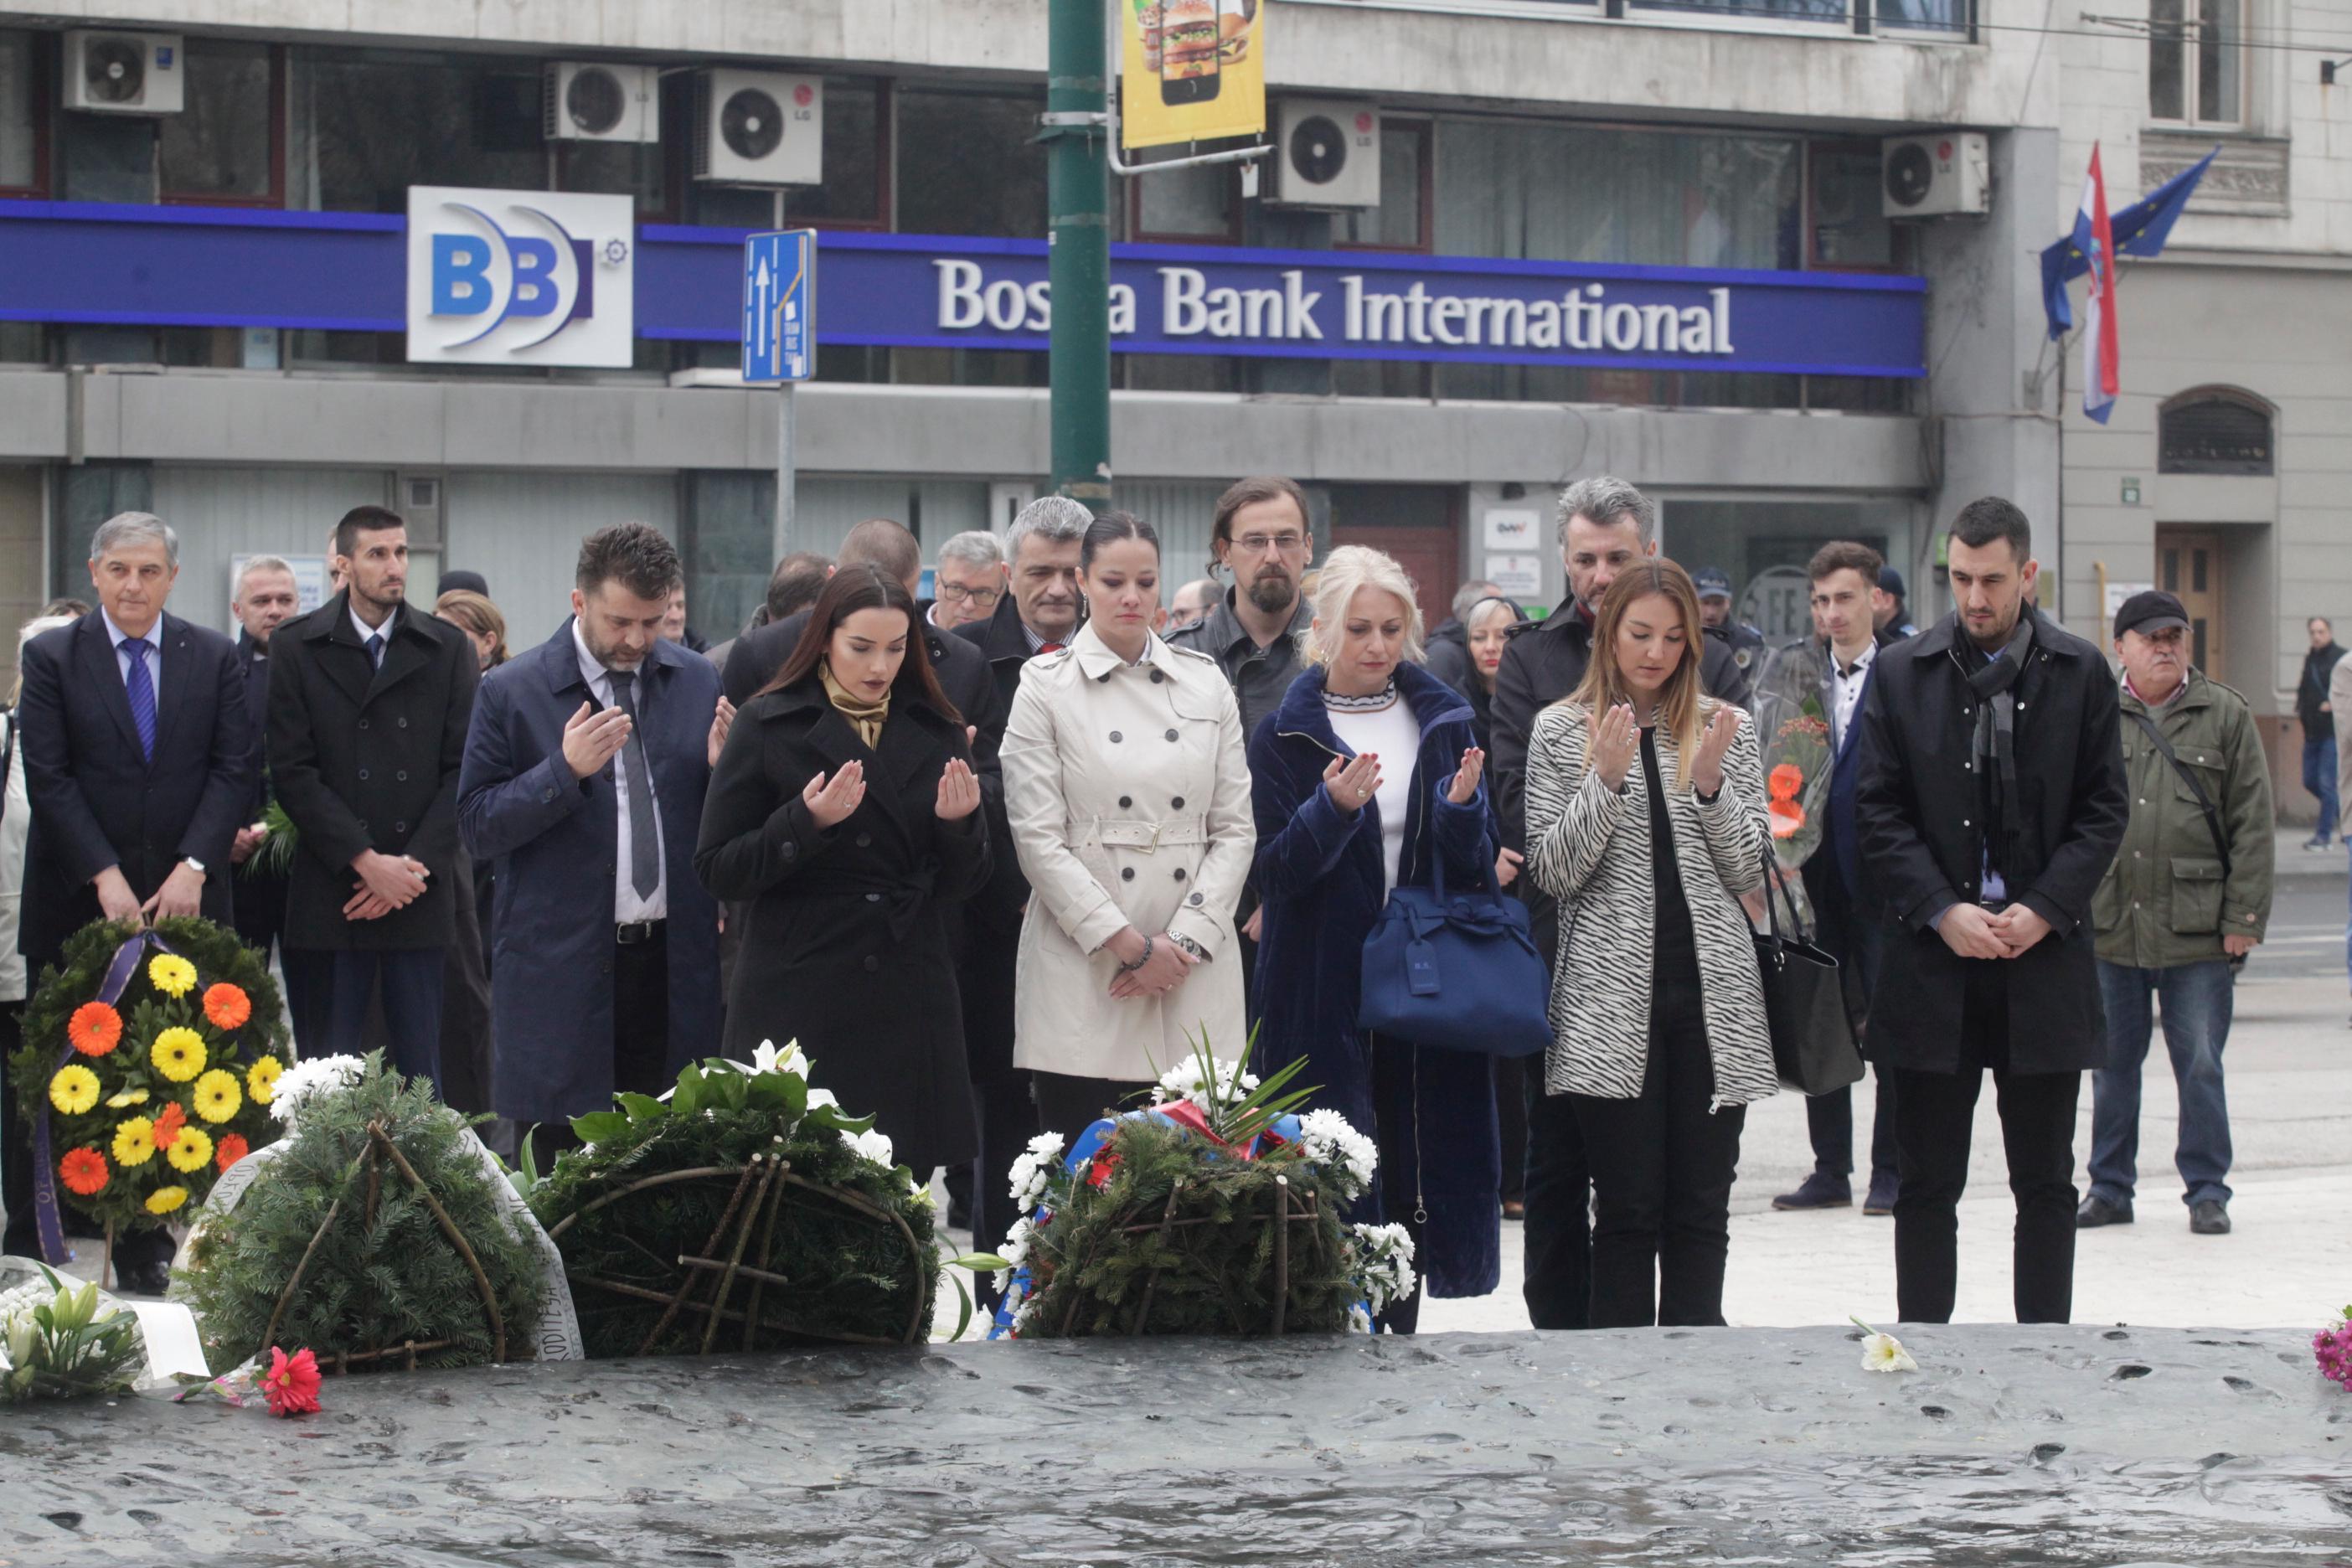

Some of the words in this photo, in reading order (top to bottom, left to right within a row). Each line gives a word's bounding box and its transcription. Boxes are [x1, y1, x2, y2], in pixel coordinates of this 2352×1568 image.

[794, 110, 812, 121] LG
[1356, 137, 1372, 147] LG
[932, 258, 1137, 333] Bosa
[1157, 266, 1324, 340] Bank
[1340, 275, 1735, 354] International
